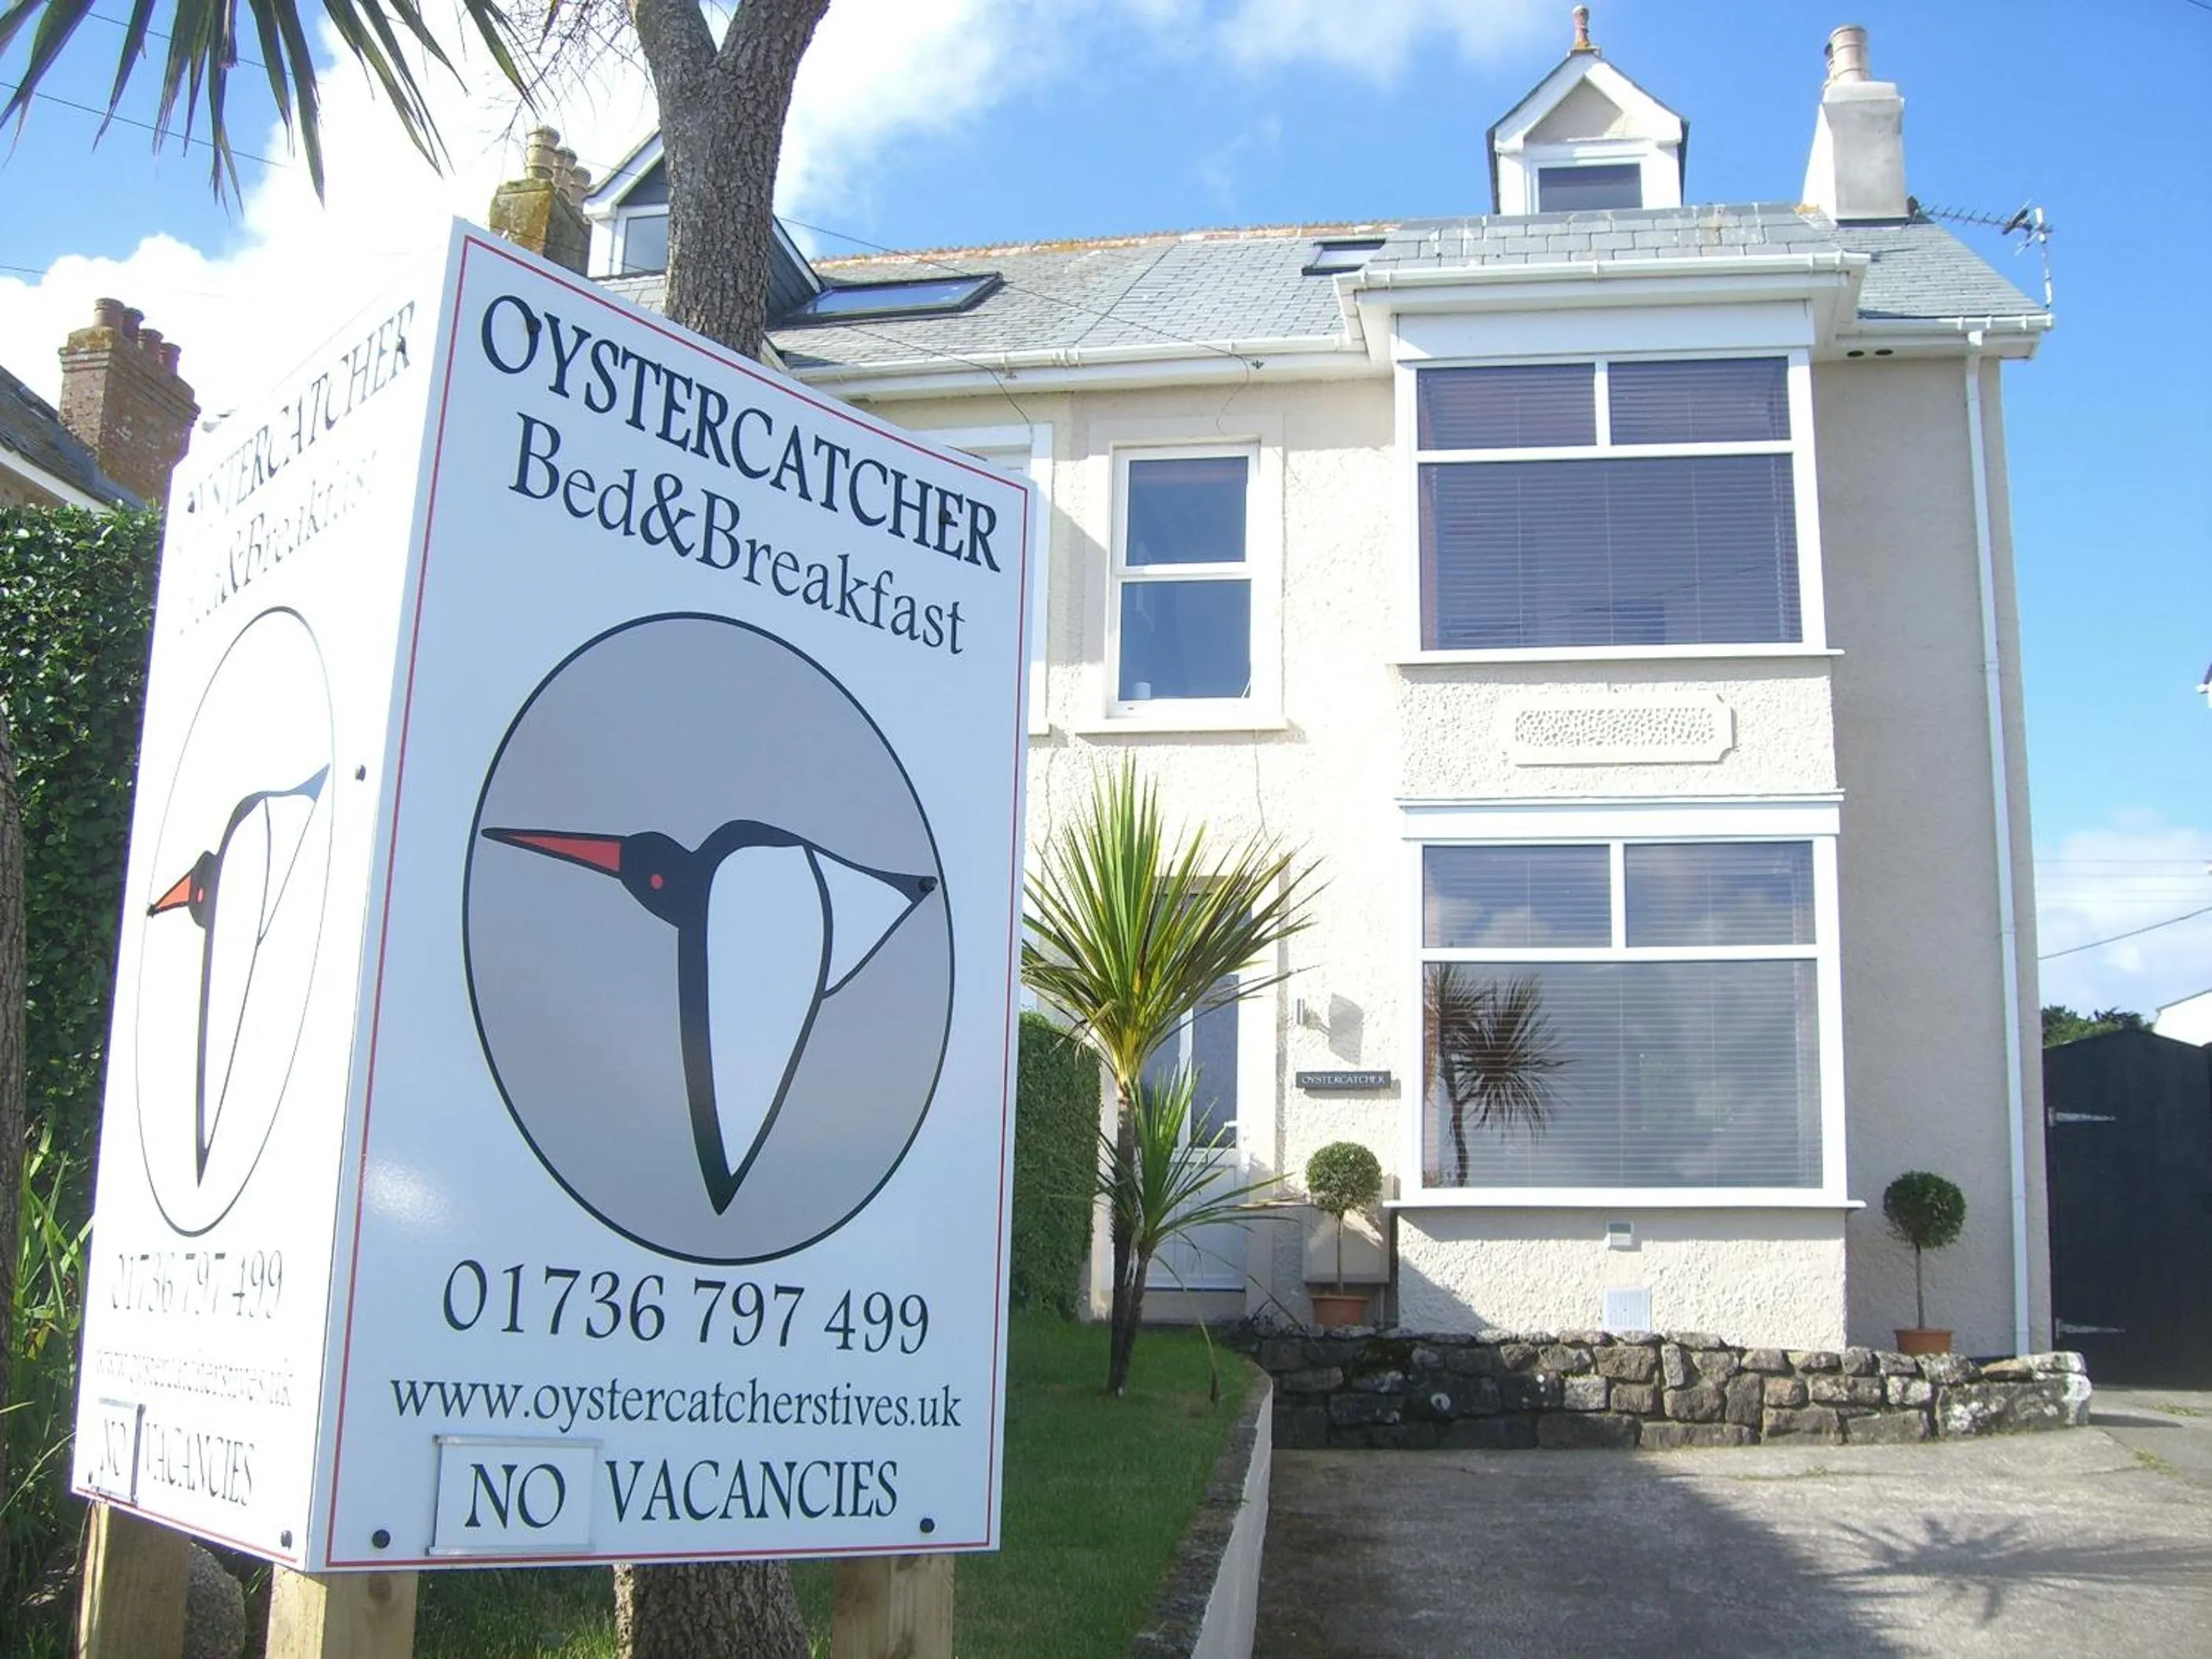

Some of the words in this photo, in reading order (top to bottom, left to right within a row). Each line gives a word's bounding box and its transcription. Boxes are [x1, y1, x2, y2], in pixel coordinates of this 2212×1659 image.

[482, 295, 1001, 573] OYSTERCATCHER
[508, 412, 966, 655] Bed&Breakfast
[233, 1251, 283, 1319] 499
[443, 1258, 665, 1342] 01736
[694, 1276, 805, 1347] 797
[823, 1288, 929, 1355] 499
[390, 1376, 962, 1434] www.oystercatcherstives.uk
[464, 1463, 566, 1530] NO
[604, 1458, 898, 1523] VACANCIES
